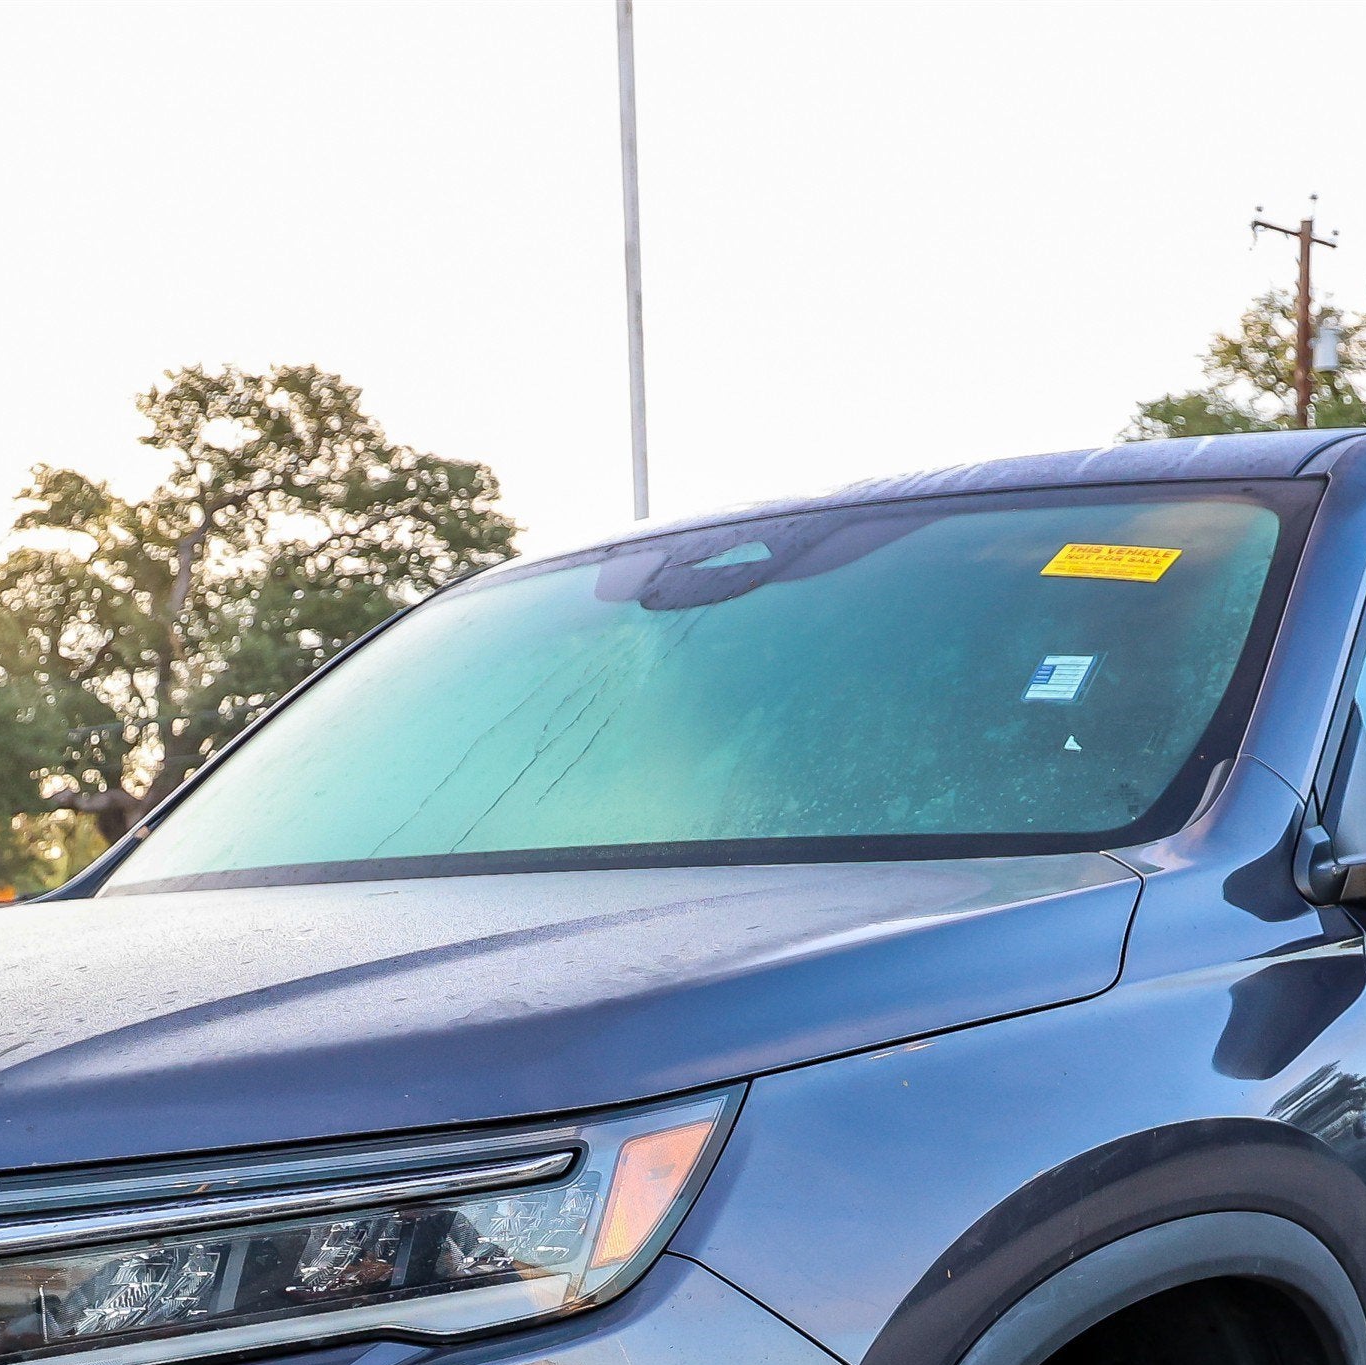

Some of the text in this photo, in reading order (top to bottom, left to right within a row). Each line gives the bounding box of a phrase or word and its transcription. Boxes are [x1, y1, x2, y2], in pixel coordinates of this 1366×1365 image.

[1069, 546, 1173, 558] THIS VEHICLE
[1127, 557, 1162, 565] SALE
